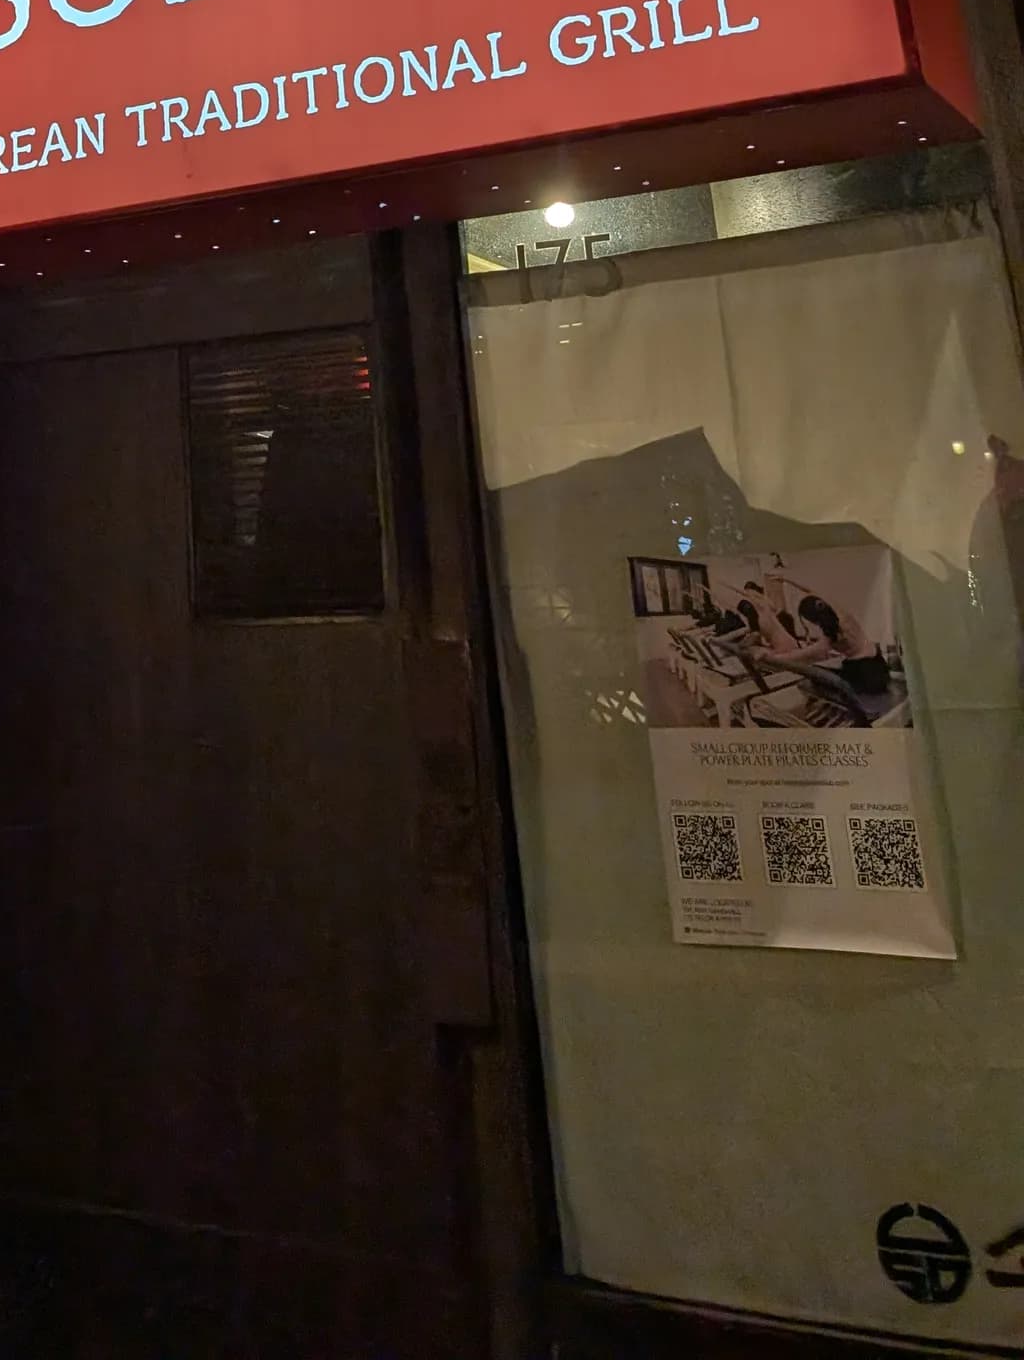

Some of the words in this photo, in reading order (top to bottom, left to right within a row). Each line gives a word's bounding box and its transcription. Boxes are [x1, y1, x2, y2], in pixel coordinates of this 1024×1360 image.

[124, 31, 527, 147] TRADITIONAL
[515, 231, 623, 304] 175
[820, 755, 869, 768] CLASSES
[864, 743, 873, 755] &
